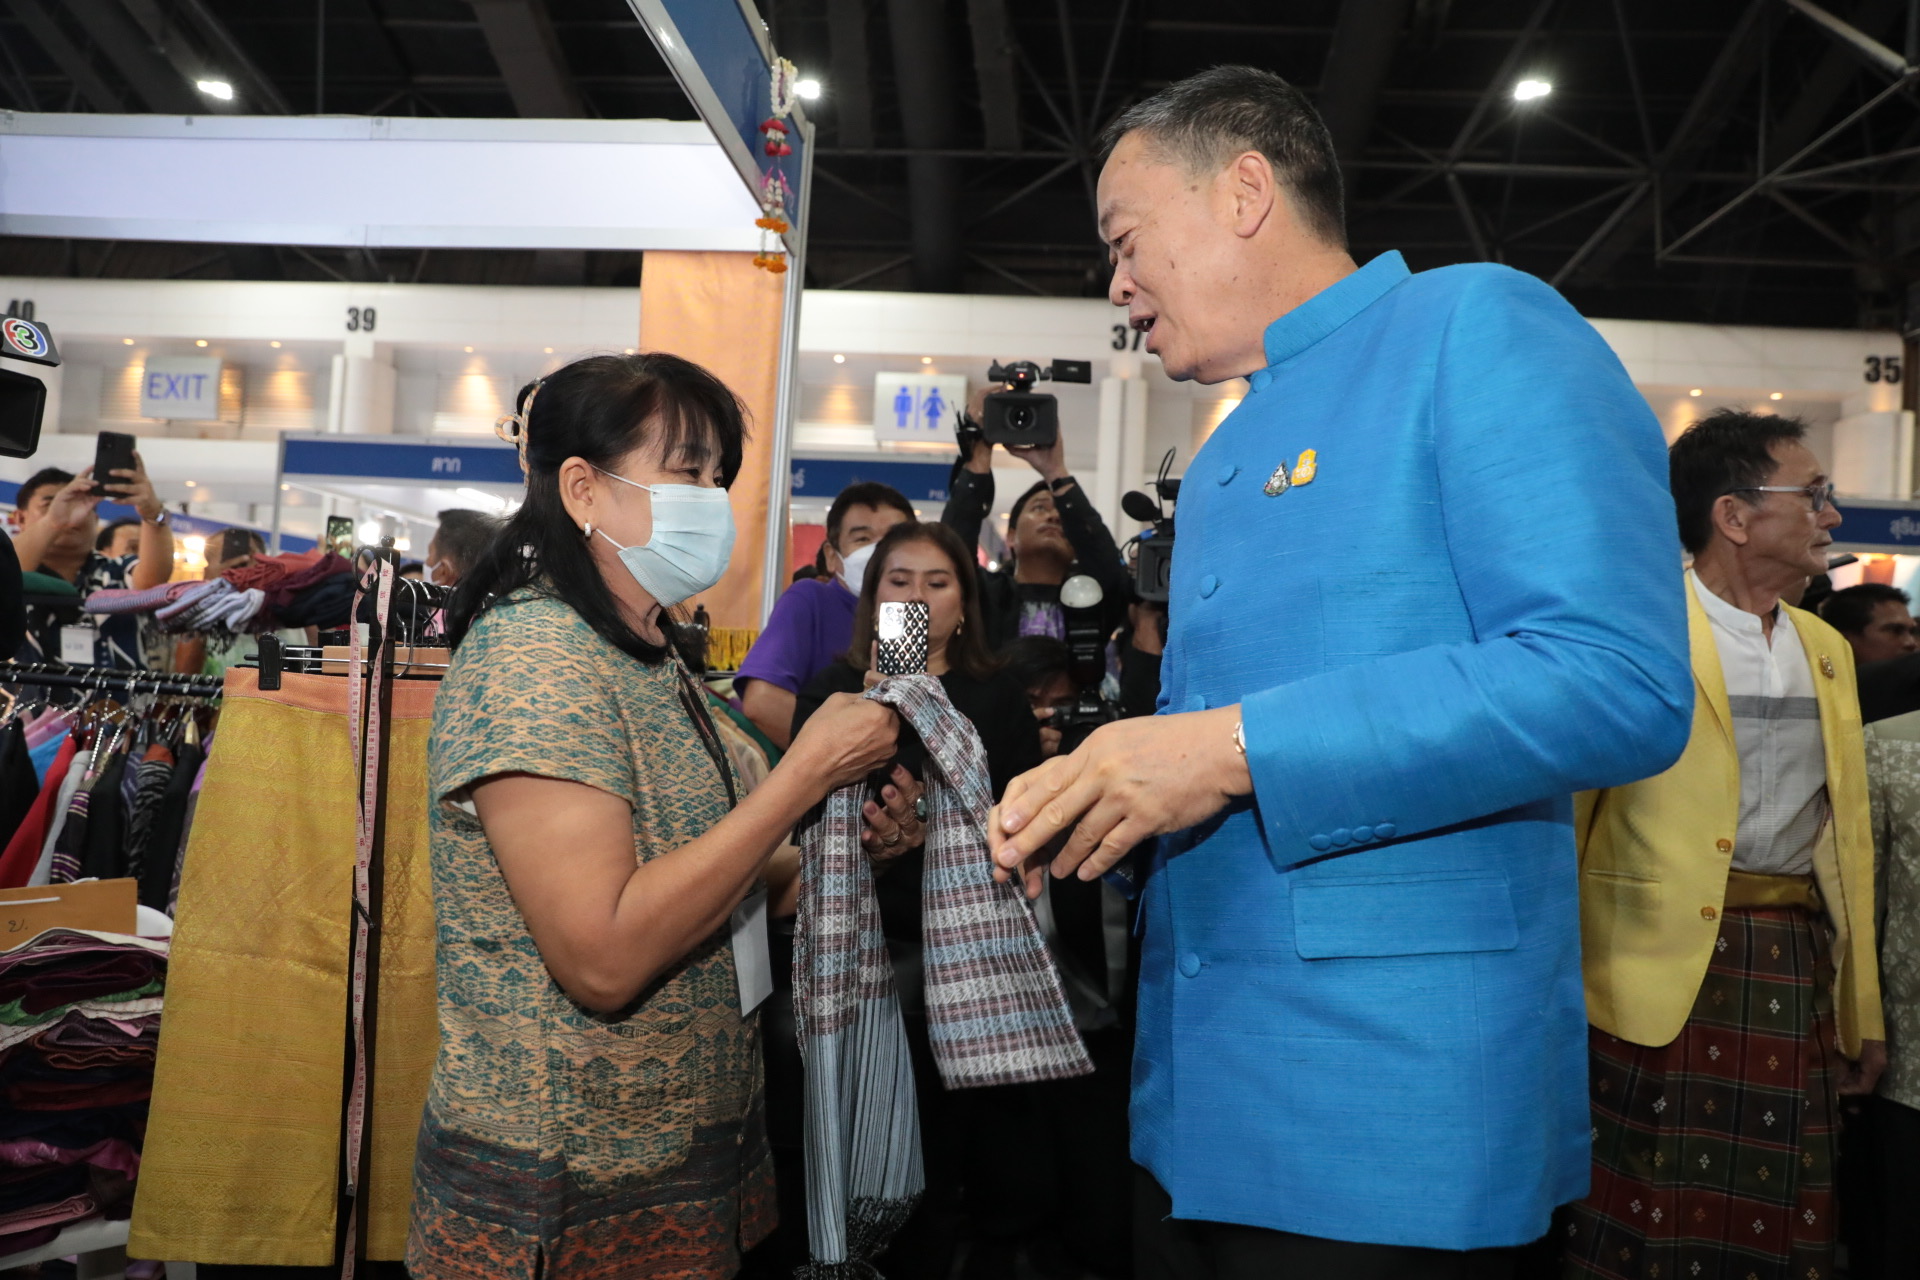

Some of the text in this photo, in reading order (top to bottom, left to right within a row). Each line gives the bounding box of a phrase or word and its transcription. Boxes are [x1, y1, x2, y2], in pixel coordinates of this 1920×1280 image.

[346, 306, 376, 332] 39
[1112, 324, 1143, 351] 37
[1864, 355, 1901, 384] 35
[147, 371, 208, 400] EXIT
